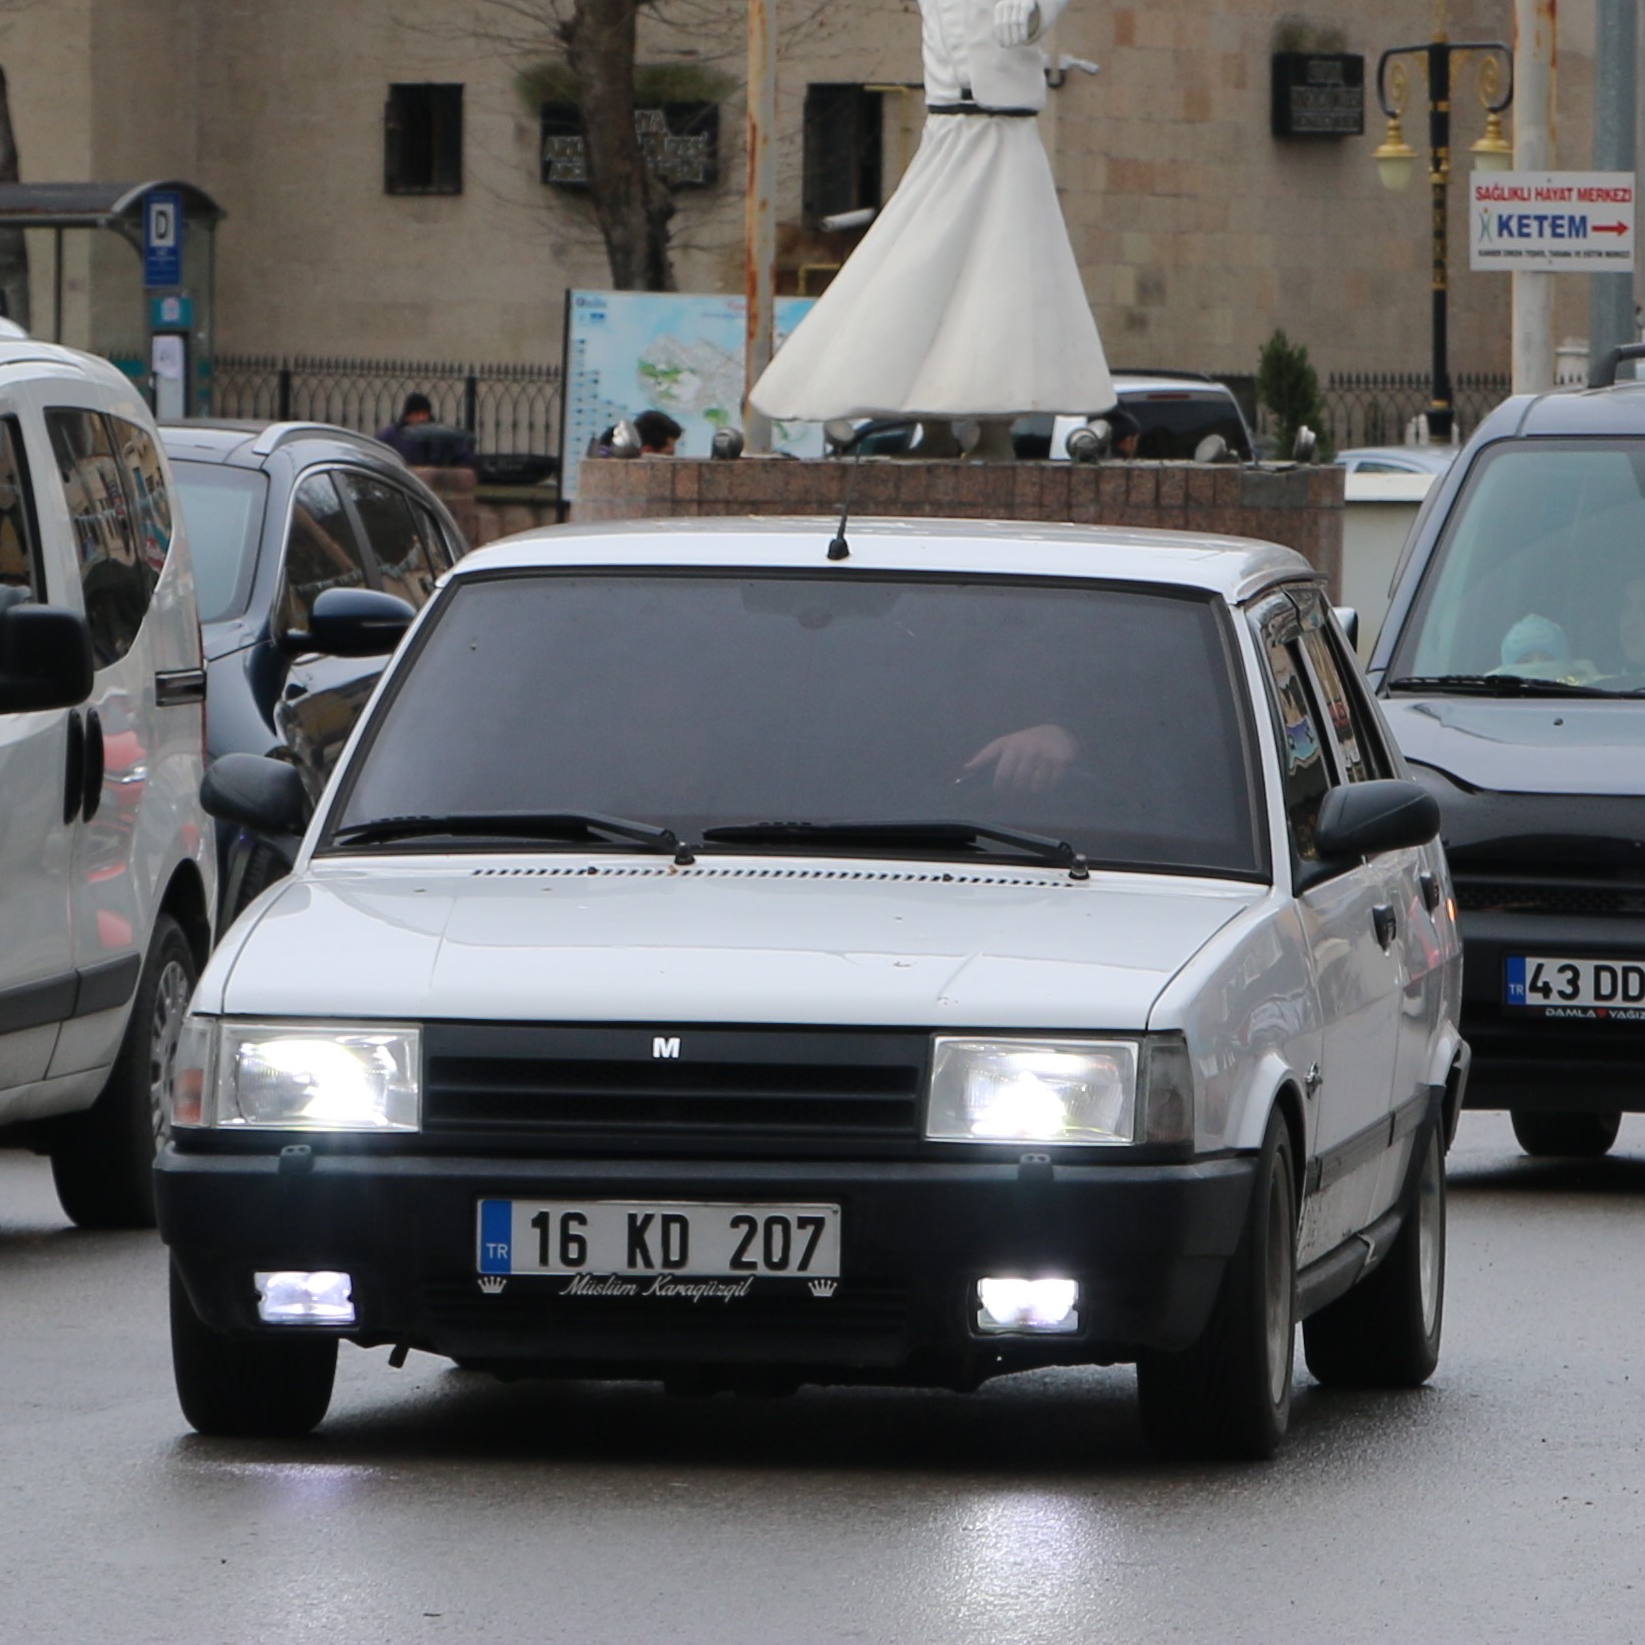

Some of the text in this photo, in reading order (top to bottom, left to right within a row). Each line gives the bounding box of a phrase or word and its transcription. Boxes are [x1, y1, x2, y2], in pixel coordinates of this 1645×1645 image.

[1475, 183, 1532, 202] SAĞLIKLI
[1534, 186, 1573, 202] HAYAT
[154, 210, 169, 240] D
[1497, 214, 1588, 239] KETEM
[1509, 984, 1525, 996] TR
[1528, 962, 1582, 1001] 43
[1545, 1008, 1598, 1019] DAMLA
[652, 1036, 681, 1058] M
[485, 1243, 509, 1260] TR
[530, 1210, 827, 1273] 16 KD 207
[558, 1274, 754, 1303] Müslüm Karagüzgil
